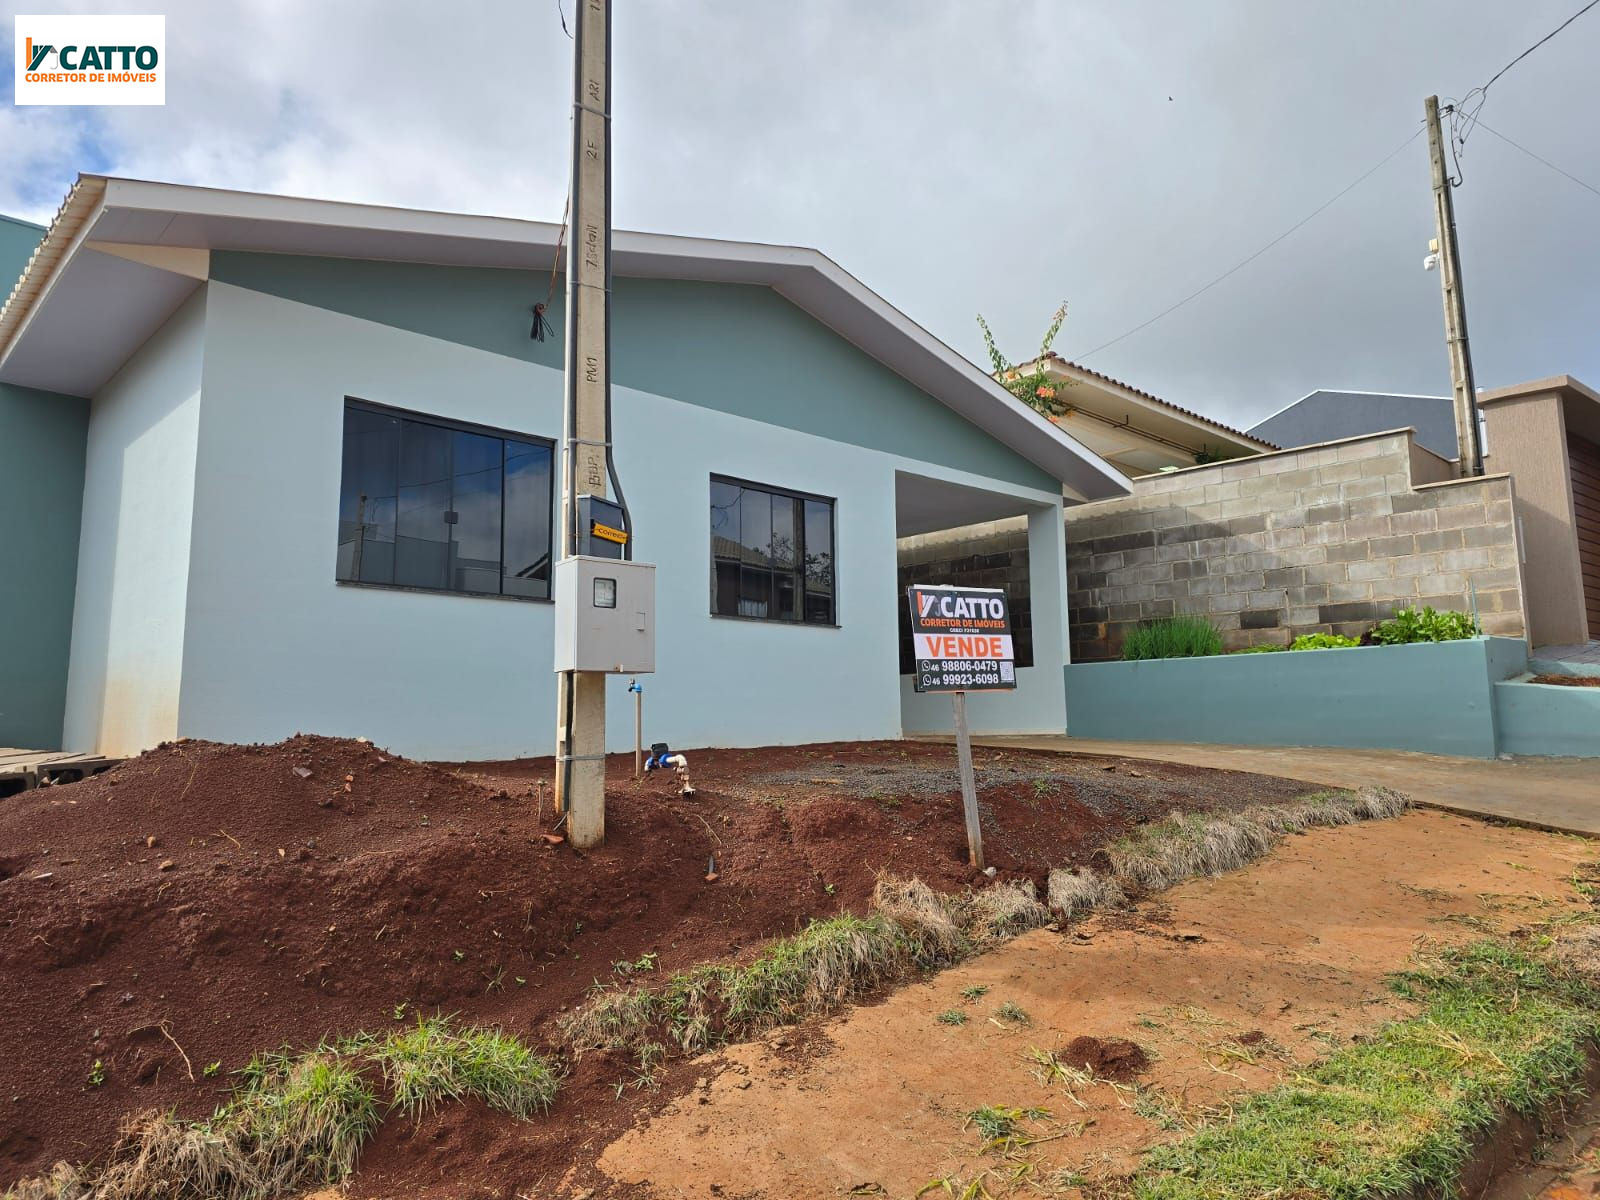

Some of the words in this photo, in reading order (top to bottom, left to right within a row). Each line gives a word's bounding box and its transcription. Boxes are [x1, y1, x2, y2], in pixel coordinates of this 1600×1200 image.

[941, 596, 1004, 619] CATTO
[920, 618, 962, 628] CORRETOR
[962, 619, 973, 628] DE
[974, 618, 1006, 629] IMÓVEIS
[925, 635, 1004, 658] VENDE
[930, 664, 940, 672] 46
[941, 660, 998, 671] 98806-0479
[942, 673, 999, 685] 99923-6098
